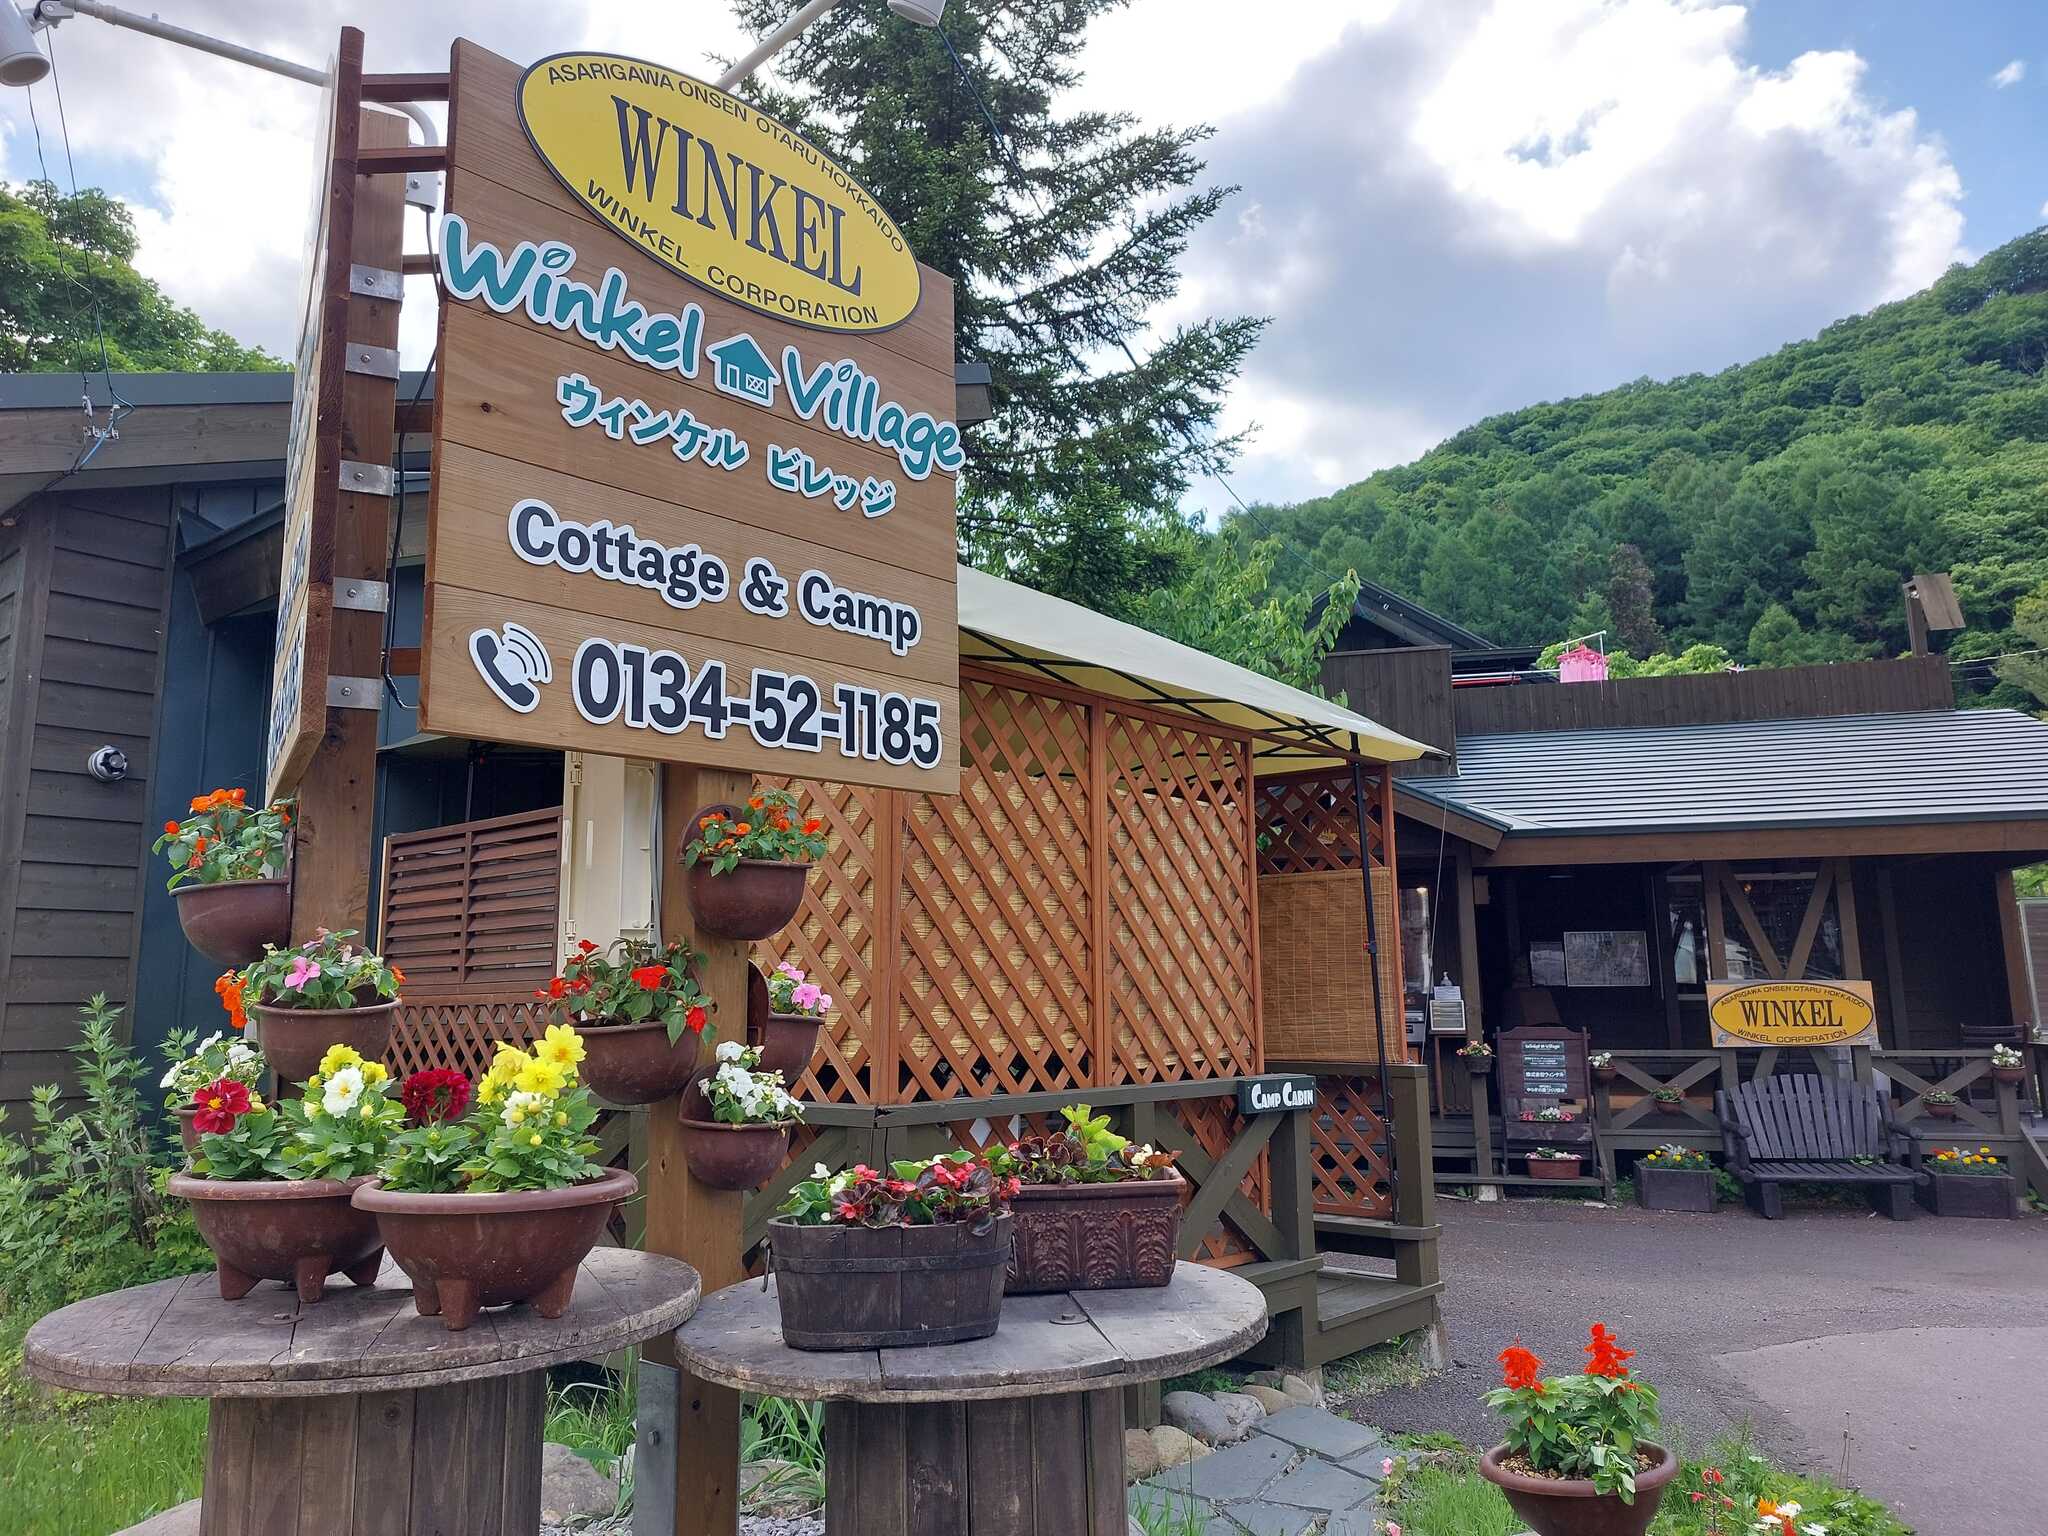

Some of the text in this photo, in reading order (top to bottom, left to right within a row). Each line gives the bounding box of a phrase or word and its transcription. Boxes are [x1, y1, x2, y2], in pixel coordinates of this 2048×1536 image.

[549, 60, 903, 253] ASARIGAWA ONSEN OTARU HOKKAIDO
[611, 94, 862, 297] WINKEL
[587, 179, 878, 324] WINKEL CORPORATION
[444, 218, 962, 476] Winkel Village
[561, 376, 894, 515] ウィンケル ビレッジ
[514, 504, 919, 652] Cottage & Camp
[576, 641, 941, 766] 0134-52-1185
[1721, 988, 1762, 1006] ASARIGAWA
[1824, 989, 1865, 1008] HOKKAIDO
[1737, 1028, 1847, 1043] WINKEL CORPORATION
[1739, 999, 1843, 1027] WINKEL
